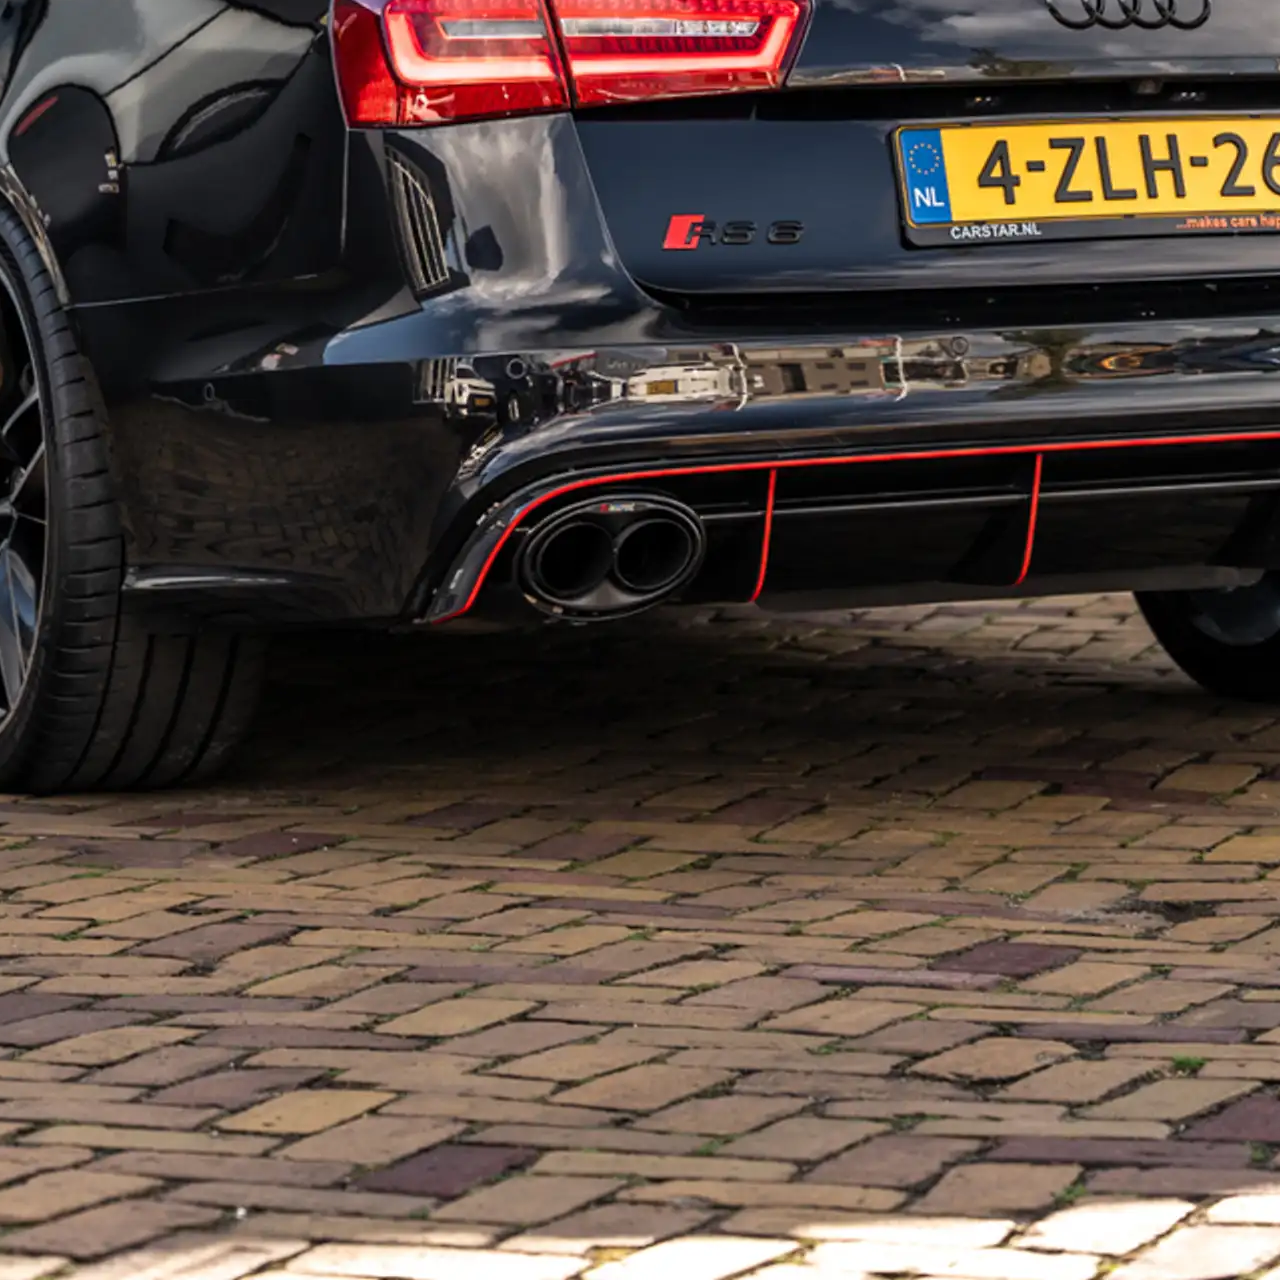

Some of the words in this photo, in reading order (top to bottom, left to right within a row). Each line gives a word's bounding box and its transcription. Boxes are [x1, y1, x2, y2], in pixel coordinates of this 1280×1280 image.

[914, 186, 945, 208] NL
[950, 222, 1042, 239] CARSTAR.NL
[1230, 216, 1257, 228] cars
